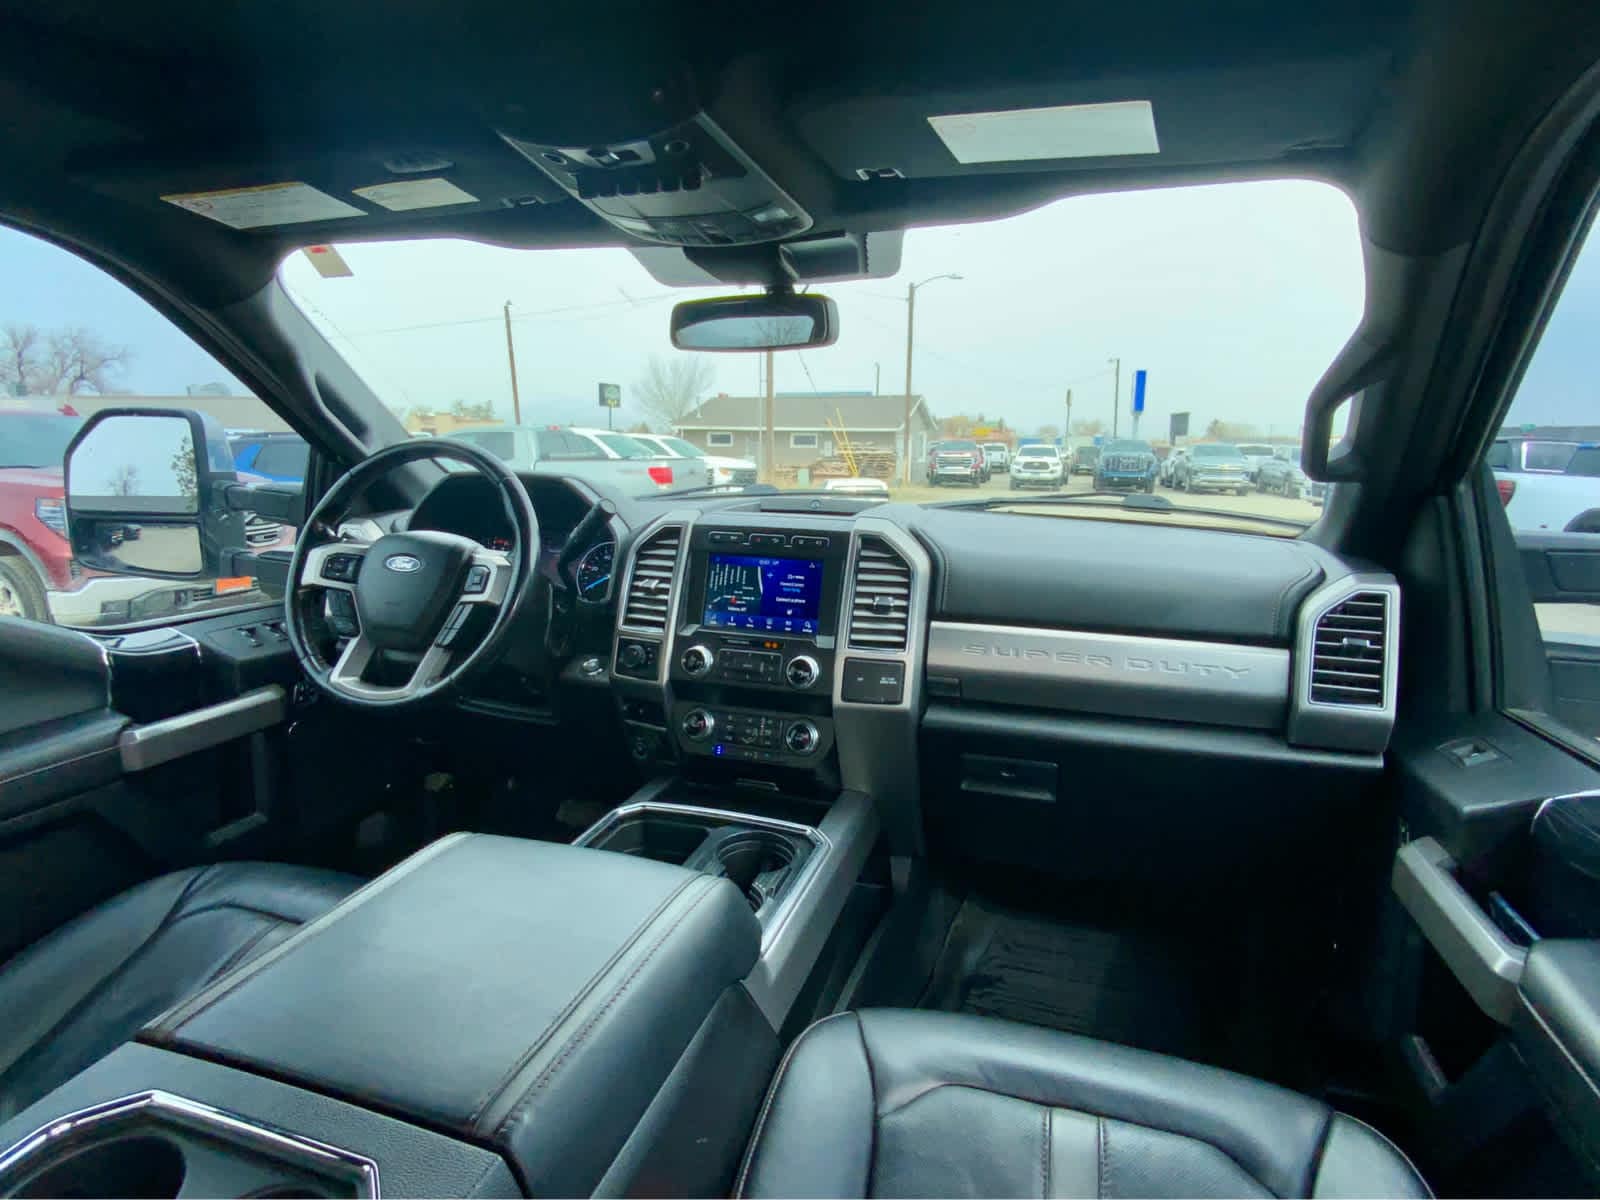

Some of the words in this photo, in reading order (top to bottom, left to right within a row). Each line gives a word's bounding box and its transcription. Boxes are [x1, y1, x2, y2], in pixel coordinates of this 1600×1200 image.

[390, 558, 416, 569] Ford
[962, 643, 1113, 669] SUPER
[1123, 656, 1252, 679] DUTY
